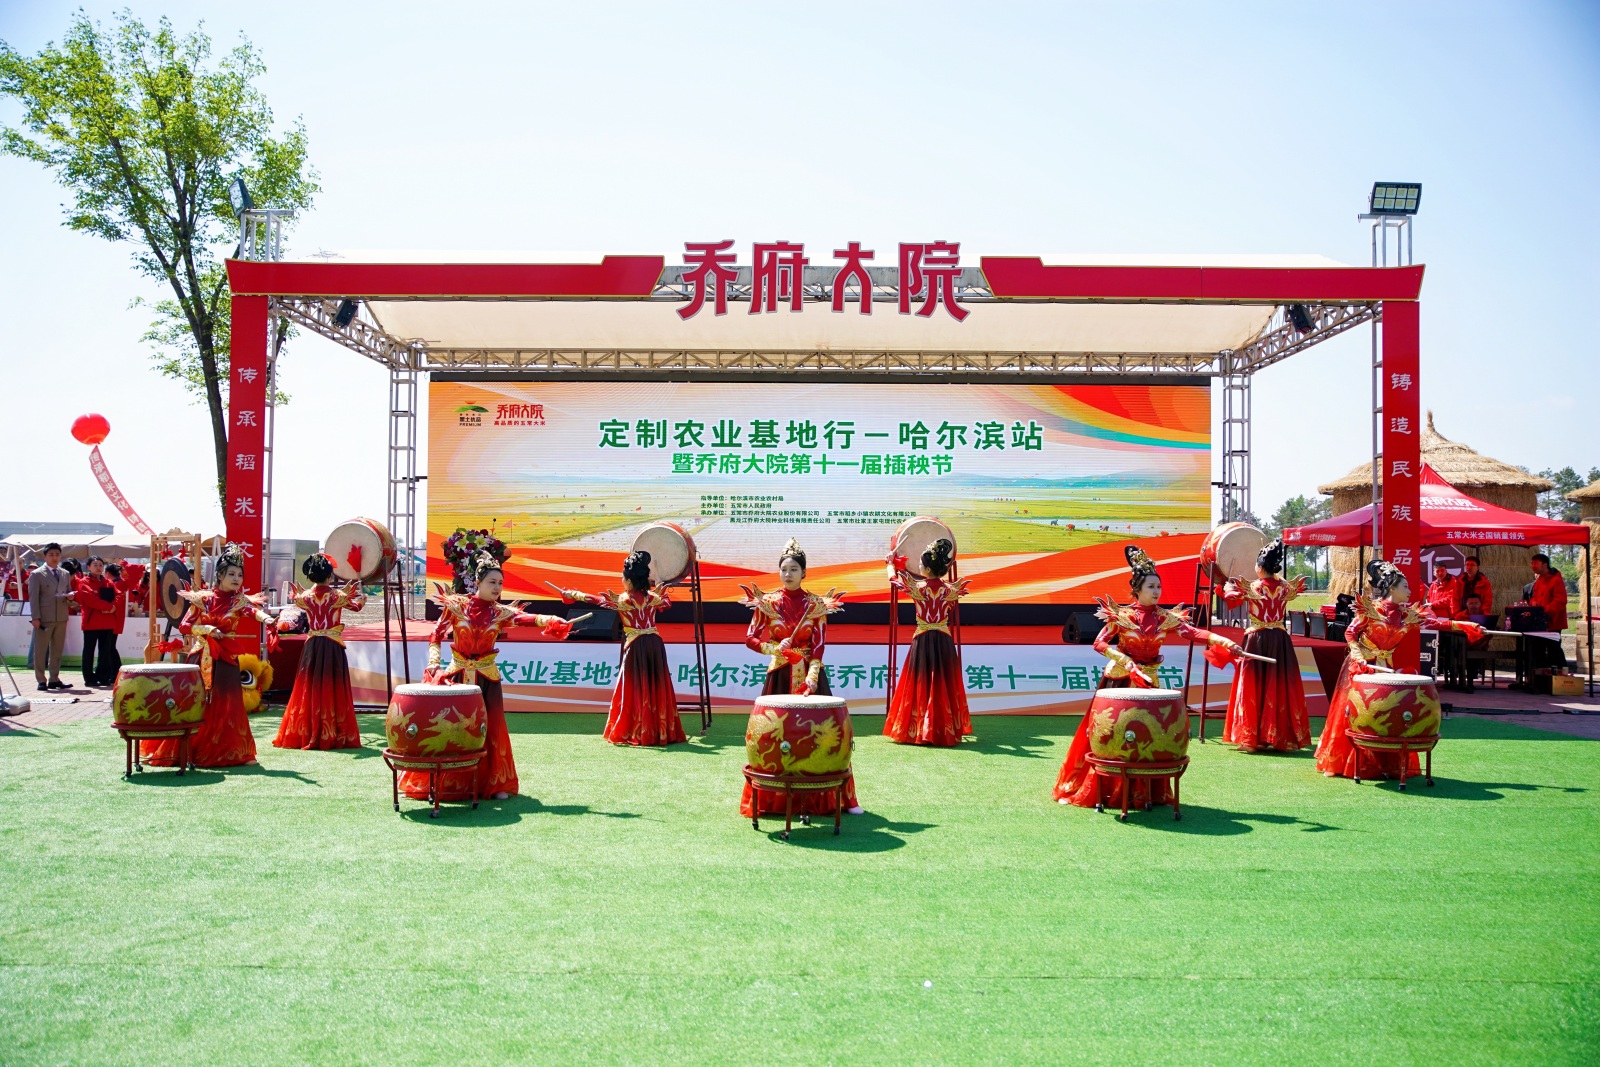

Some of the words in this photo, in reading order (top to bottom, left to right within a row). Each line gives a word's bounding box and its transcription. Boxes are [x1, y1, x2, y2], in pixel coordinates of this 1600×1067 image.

[675, 239, 971, 323] 乔府大院
[496, 404, 545, 420] 乔府大院
[671, 452, 954, 475] 暨乔府大院第十一届插秧节
[1390, 373, 1413, 608] 铸造民族品
[1446, 531, 1525, 540] 五常大米全国销量领先
